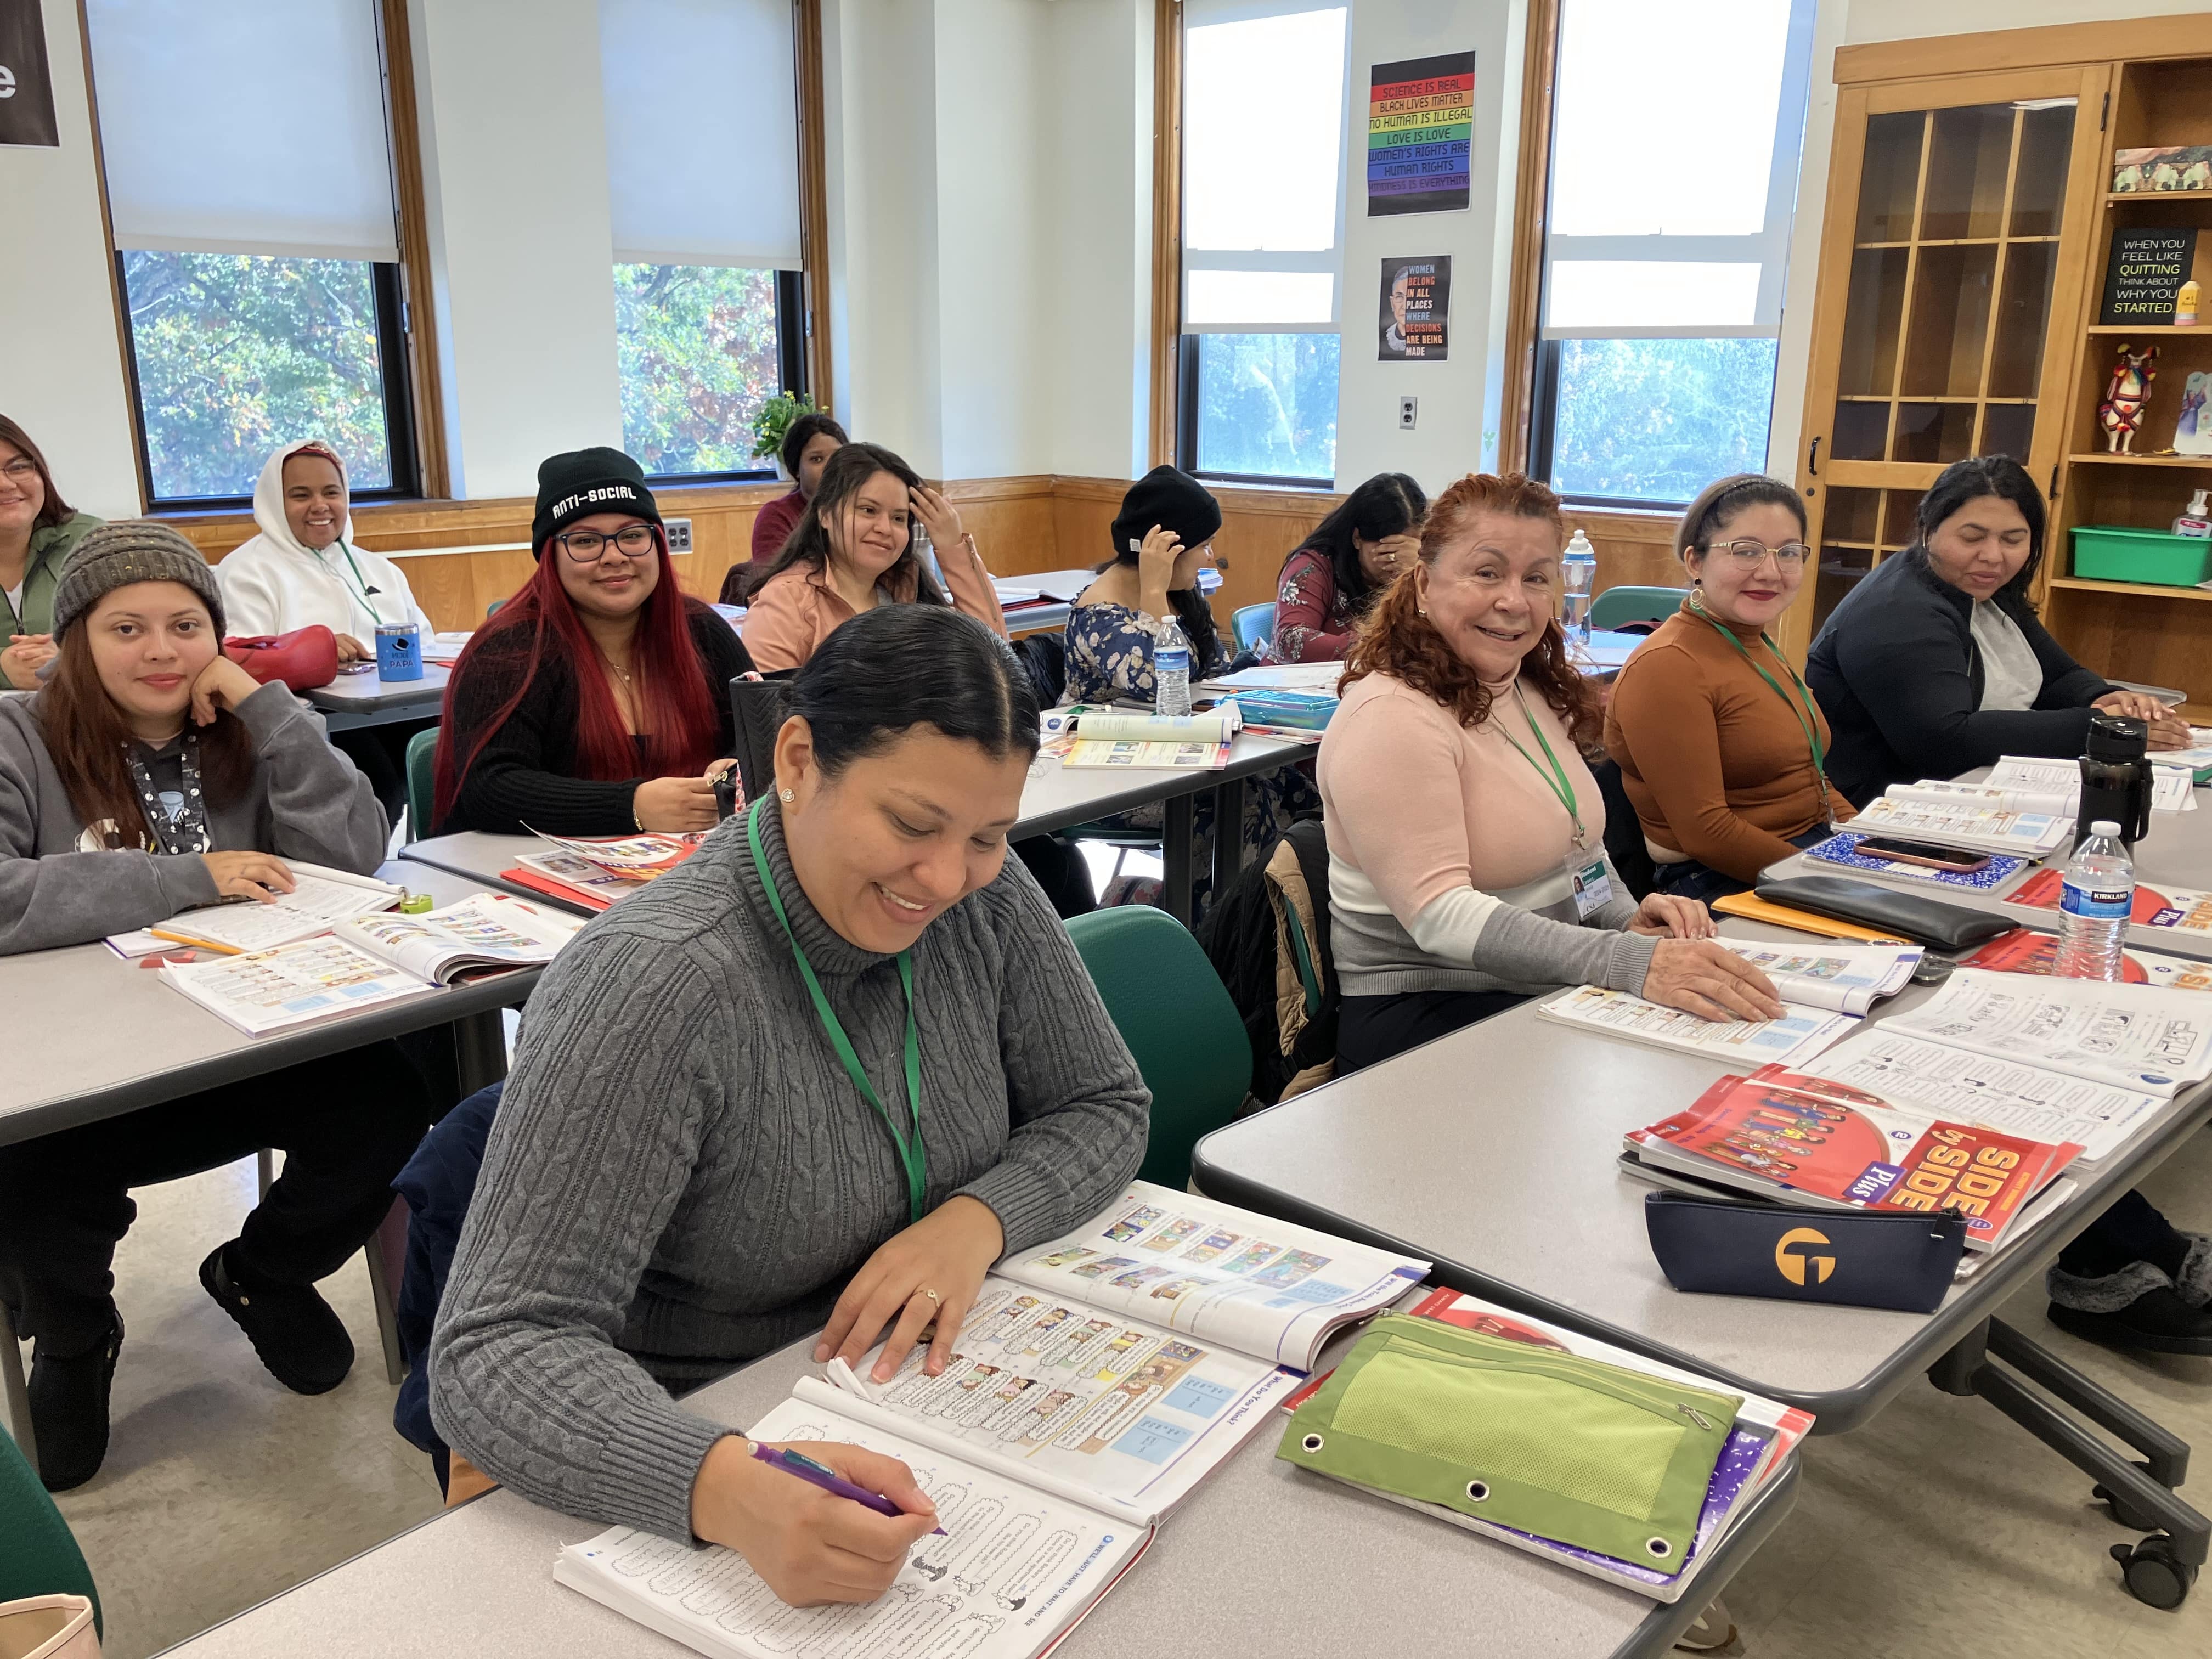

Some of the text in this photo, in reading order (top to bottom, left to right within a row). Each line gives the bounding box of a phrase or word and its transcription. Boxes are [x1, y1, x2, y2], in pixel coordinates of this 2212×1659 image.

[1383, 79, 1461, 98] SCIENCE IS REAL
[1380, 93, 1463, 112] BLACK LIVES MATTER
[1369, 108, 1472, 129] NO HUMAN IS ILLEGAL
[1387, 128, 1451, 145] LOVE IS LOVE
[1369, 142, 1469, 161] WOMEN'S RIGHTS ARE
[1385, 160, 1453, 176] HUMAN RIGHTS
[1369, 175, 1469, 192] KINDNESS IS EVERYTHING
[2124, 240, 2185, 249] WHEN YOU
[2122, 252, 2183, 261] FEEL LIKE
[1409, 265, 1435, 274] WOMEN
[2120, 264, 2180, 276] QUITTING
[1408, 276, 1435, 285] BELONG
[1407, 289, 1430, 297] IN ALL
[2117, 289, 2177, 298] WHY YOU
[1406, 300, 1432, 309] PLACES
[2114, 303, 2175, 313] STARTED.
[1406, 312, 1430, 321] WHERE
[1406, 324, 1441, 332] DECISIONS
[1407, 335, 1442, 344] ARE BEING
[1406, 347, 1425, 356] MADE
[552, 486, 636, 519] ANTI-SOCIAL
[2153, 910, 2180, 924] Plus
[1890, 1130, 1976, 1211] by SIDE
[1853, 1166, 1896, 1198] Plus
[1942, 1147, 2019, 1216] SIDE
[1386, 1277, 1397, 1286] Will
[1364, 1290, 1379, 1300] Train
[1424, 1294, 1449, 1316] ALWAYS LEAR
[1226, 1374, 1283, 1426] What Do You Think?
[1099, 1419, 1122, 1439] tomorrow?
[938, 1499, 948, 1507] you
[958, 1519, 972, 1531] beach
[969, 1520, 980, 1530] think
[1013, 1528, 1024, 1537] you
[1005, 1537, 1017, 1547] think
[1051, 1534, 1064, 1545] move
[931, 1538, 953, 1557] weekend?
[988, 1546, 997, 1554] new
[1053, 1544, 1065, 1552] you
[1087, 1544, 1106, 1559] WE'LL
[935, 1553, 947, 1562] drive
[978, 1554, 990, 1564] job?
[991, 1547, 1007, 1561] Robert
[1035, 1555, 1046, 1564] new
[1046, 1553, 1058, 1562] think
[1030, 1562, 1048, 1578] Barbara
[1076, 1559, 1092, 1572] JUST
[1014, 1563, 1038, 1584] apartment
[1064, 1572, 1081, 1585] HAVE
[1003, 1583, 1018, 1595] soon?
[881, 1599, 895, 1609] don't
[1045, 1593, 1060, 1606] WAIT
[815, 1603, 834, 1617] Maybe
[926, 1609, 940, 1620] don't
[1033, 1606, 1048, 1617] AND
[894, 1617, 912, 1631] maybe
[1023, 1617, 1036, 1626] SEE
[850, 1621, 868, 1635] Maybe
[964, 1627, 981, 1640] don't
[895, 1632, 915, 1646] Maybe
[934, 1628, 961, 1651] and maybe
[953, 1639, 969, 1651] know.
